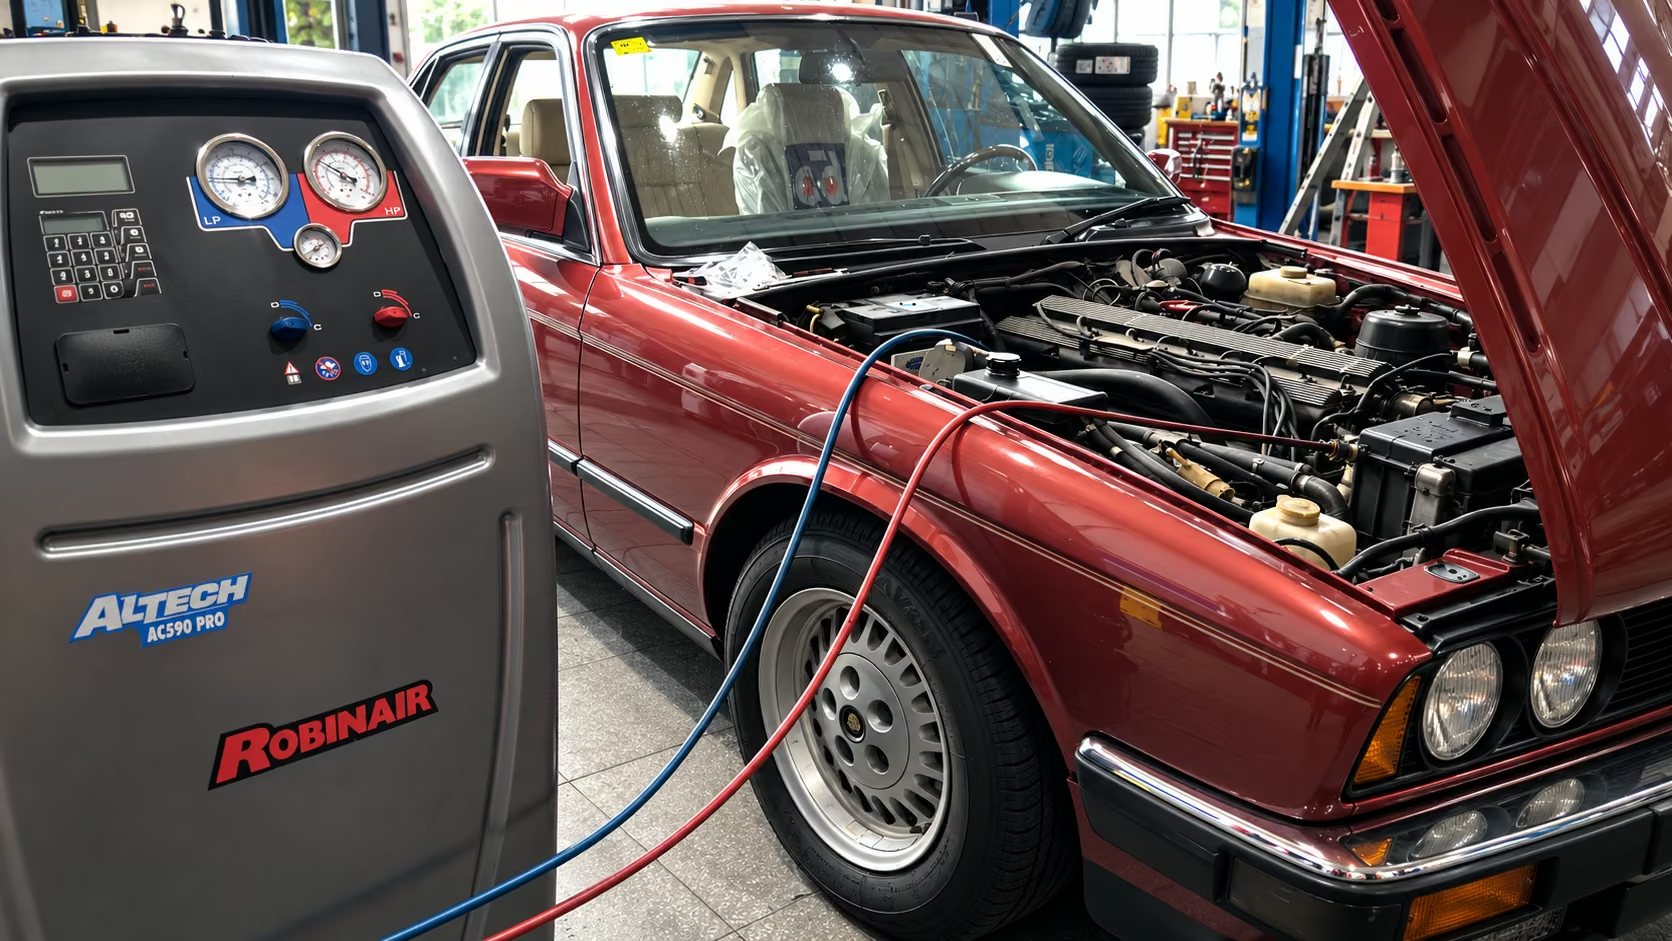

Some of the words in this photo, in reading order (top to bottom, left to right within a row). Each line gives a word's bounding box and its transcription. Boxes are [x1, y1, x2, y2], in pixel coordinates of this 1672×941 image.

[204, 216, 221, 225] LP
[384, 207, 400, 215] HP
[313, 323, 322, 331] C
[74, 575, 249, 638] ALTECH
[147, 619, 192, 643] AC590
[196, 611, 225, 632] PRO
[216, 684, 432, 784] ROBINAIR
